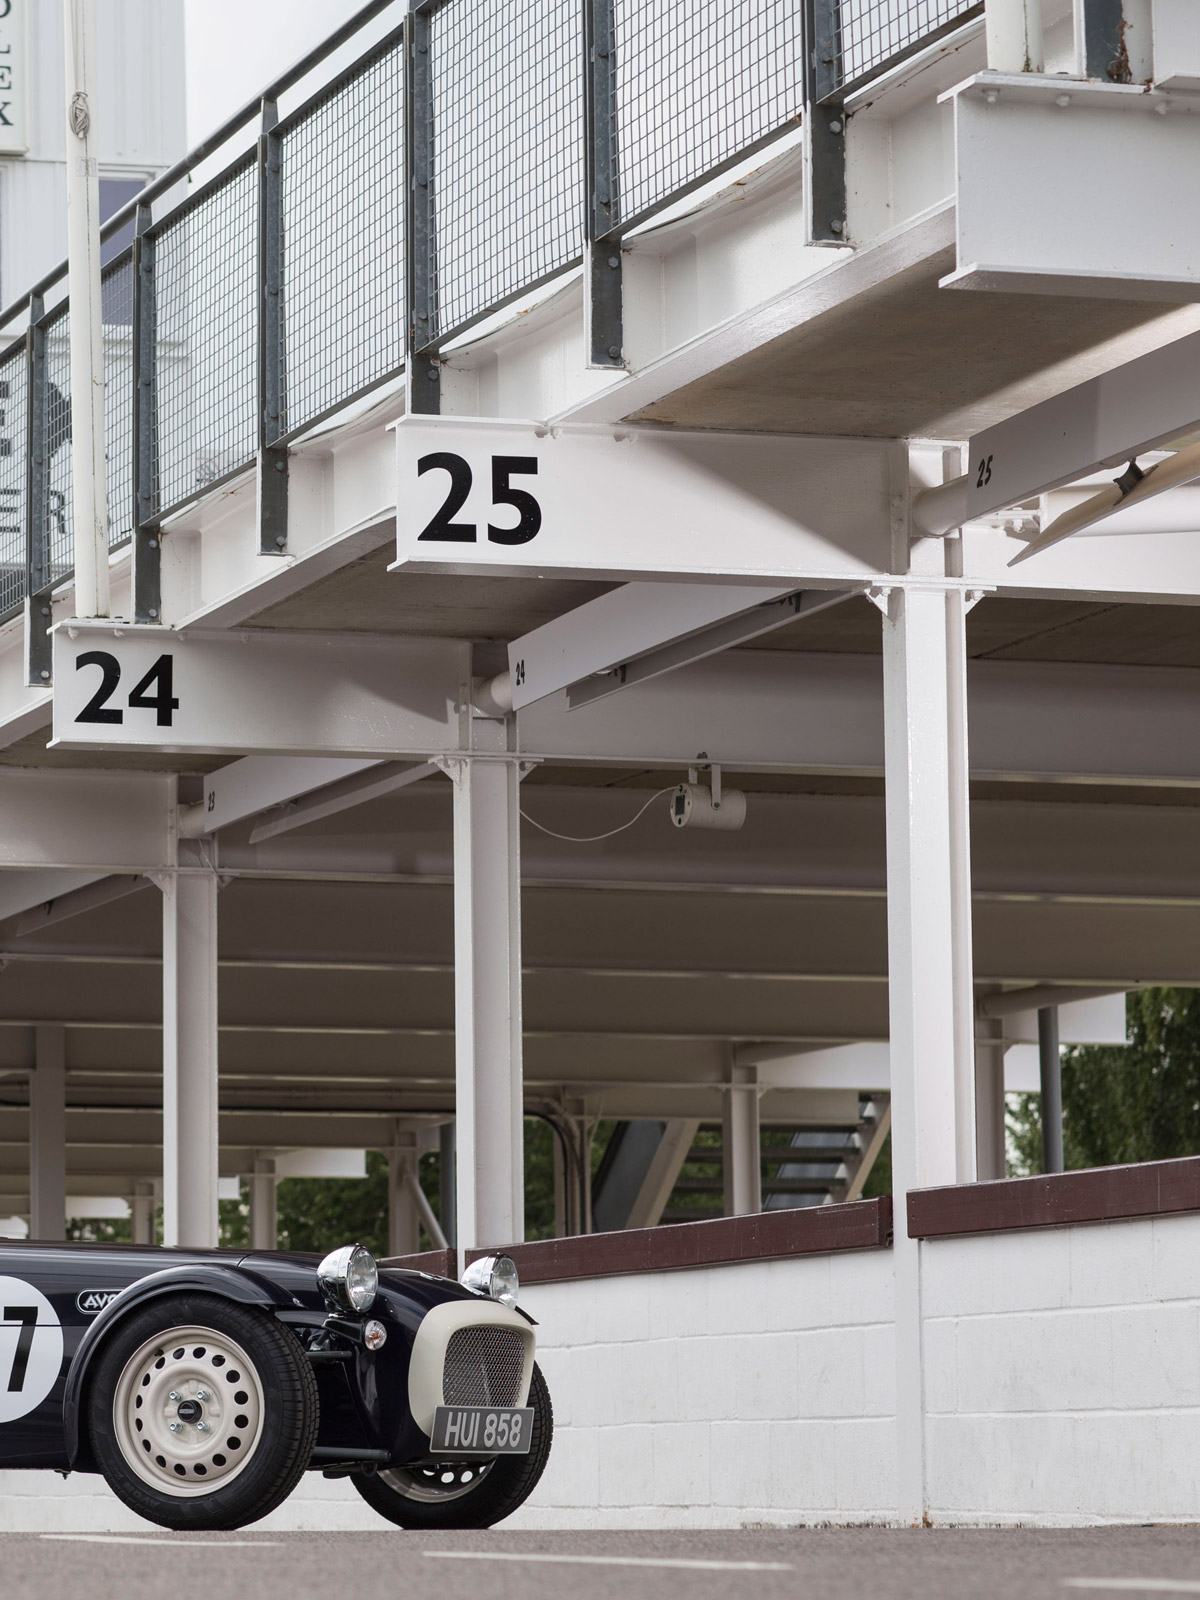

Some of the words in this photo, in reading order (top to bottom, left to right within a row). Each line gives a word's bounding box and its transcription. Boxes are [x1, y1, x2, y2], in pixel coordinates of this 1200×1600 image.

[976, 454, 994, 488] 25
[417, 452, 542, 545] 25
[74, 650, 179, 726] 24
[515, 659, 525, 686] 24
[445, 1412, 480, 1447] HUI
[484, 1413, 522, 1447] 858
